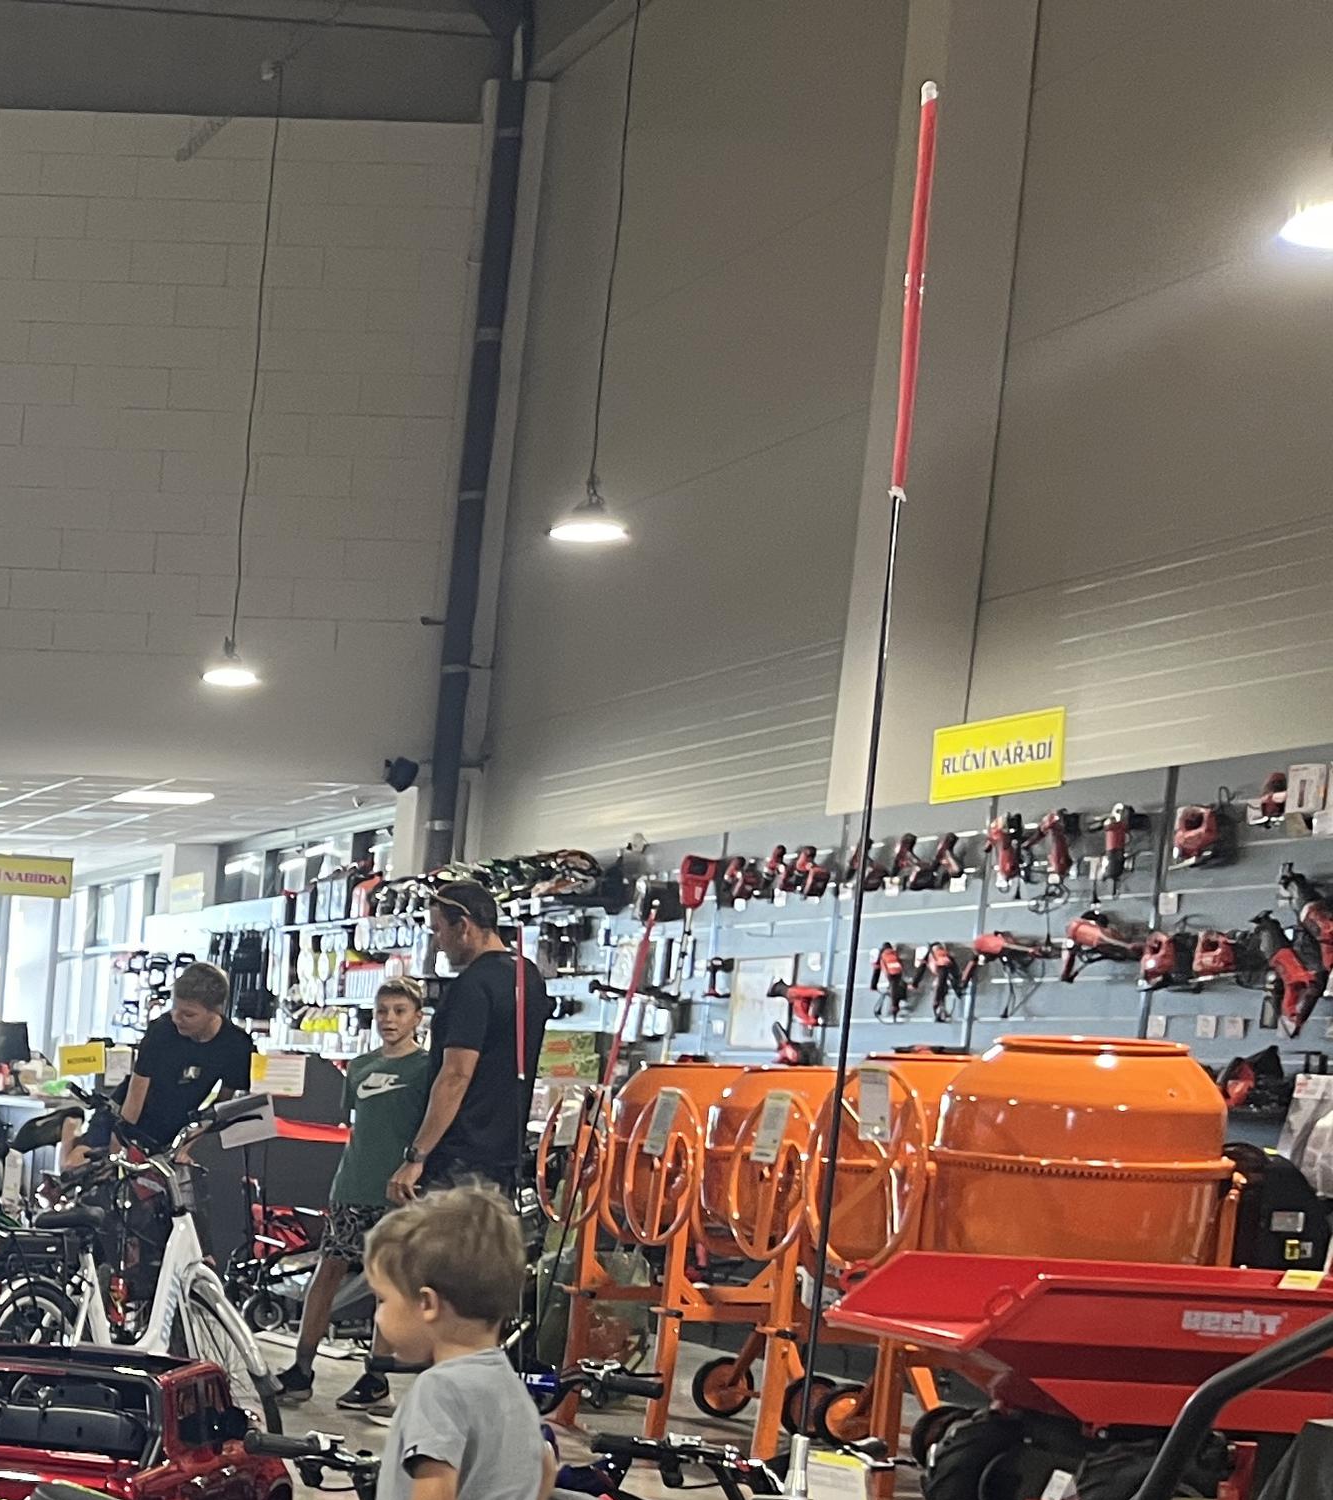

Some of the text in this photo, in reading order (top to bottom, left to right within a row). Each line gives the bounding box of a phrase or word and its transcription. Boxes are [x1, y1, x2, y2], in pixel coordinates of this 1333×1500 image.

[941, 734, 1053, 775] RUČNÍ NÁŘADÍ
[4, 871, 67, 885] NABÍDKA
